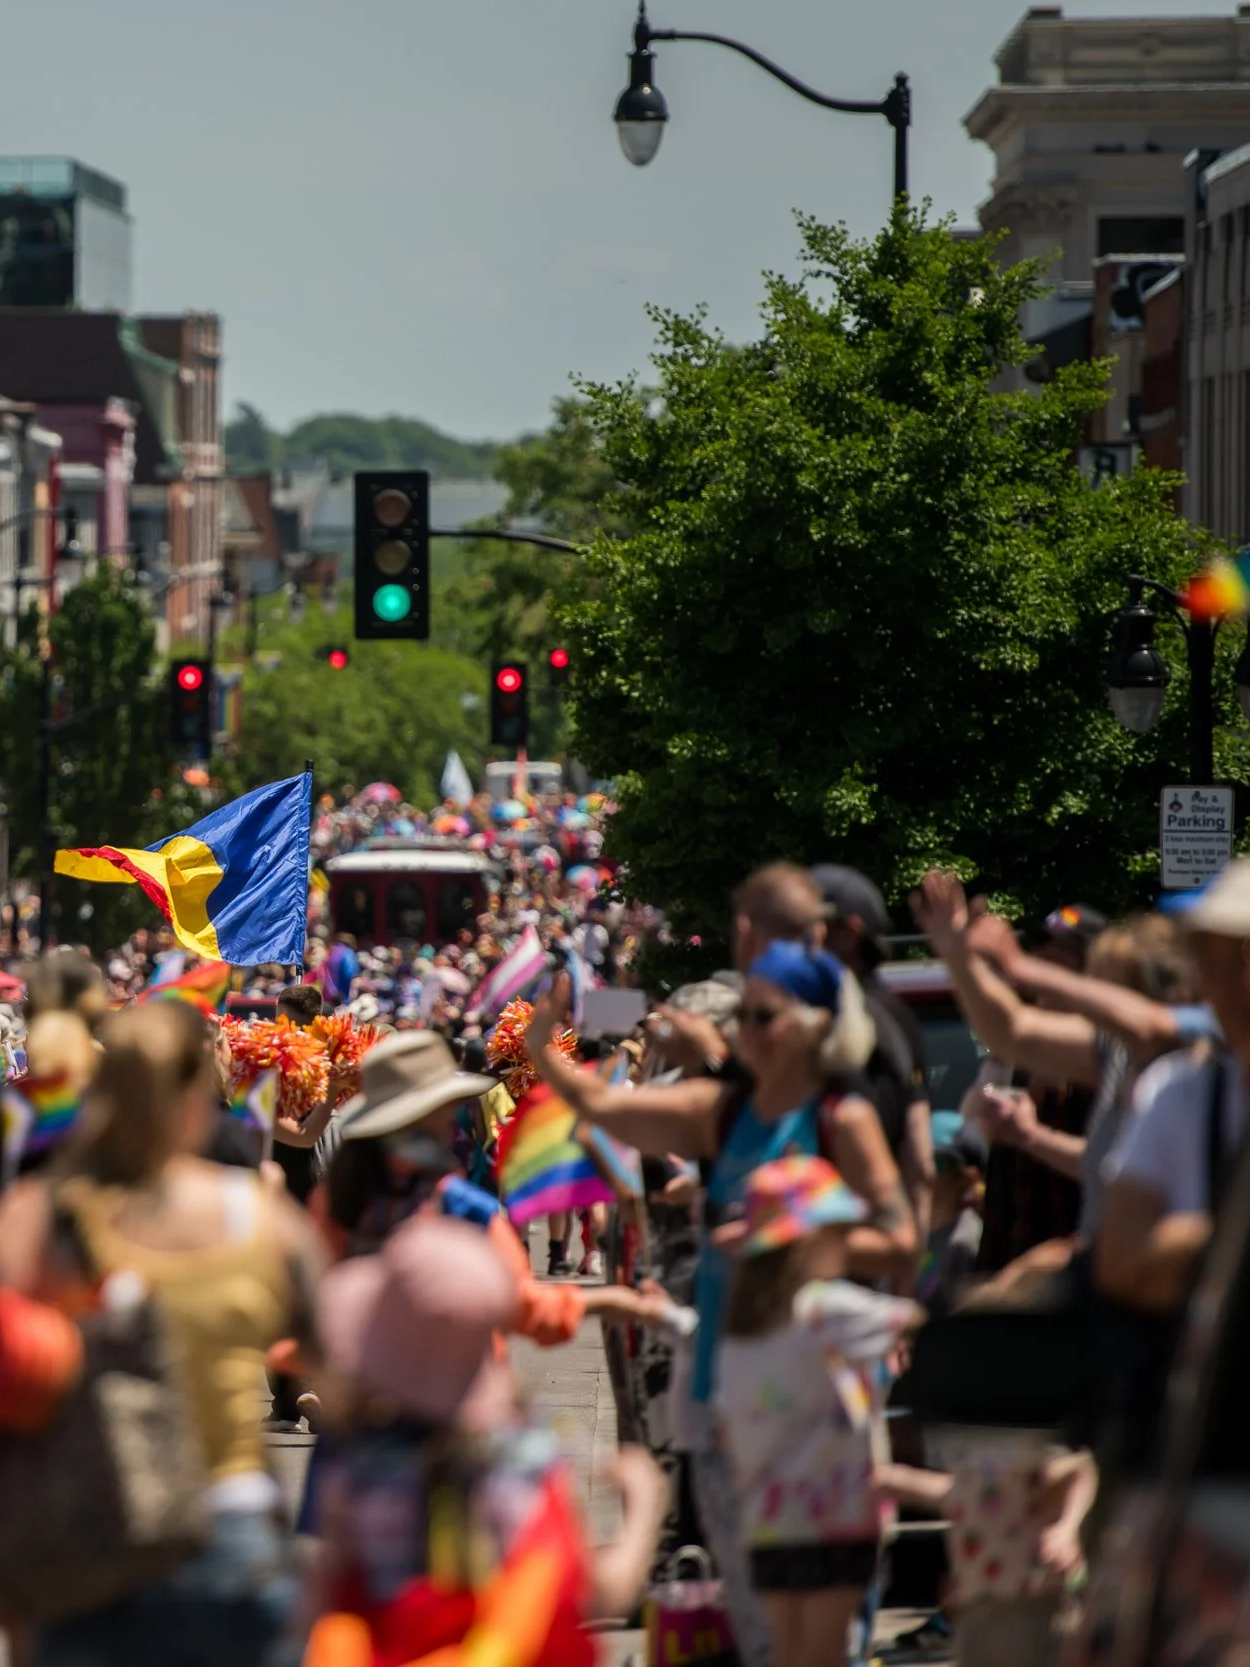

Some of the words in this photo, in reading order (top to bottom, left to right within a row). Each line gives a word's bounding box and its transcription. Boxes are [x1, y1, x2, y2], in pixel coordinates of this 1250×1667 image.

[1191, 795, 1208, 804] Pay
[1191, 805, 1226, 815] Display
[1167, 814, 1226, 831] Parking
